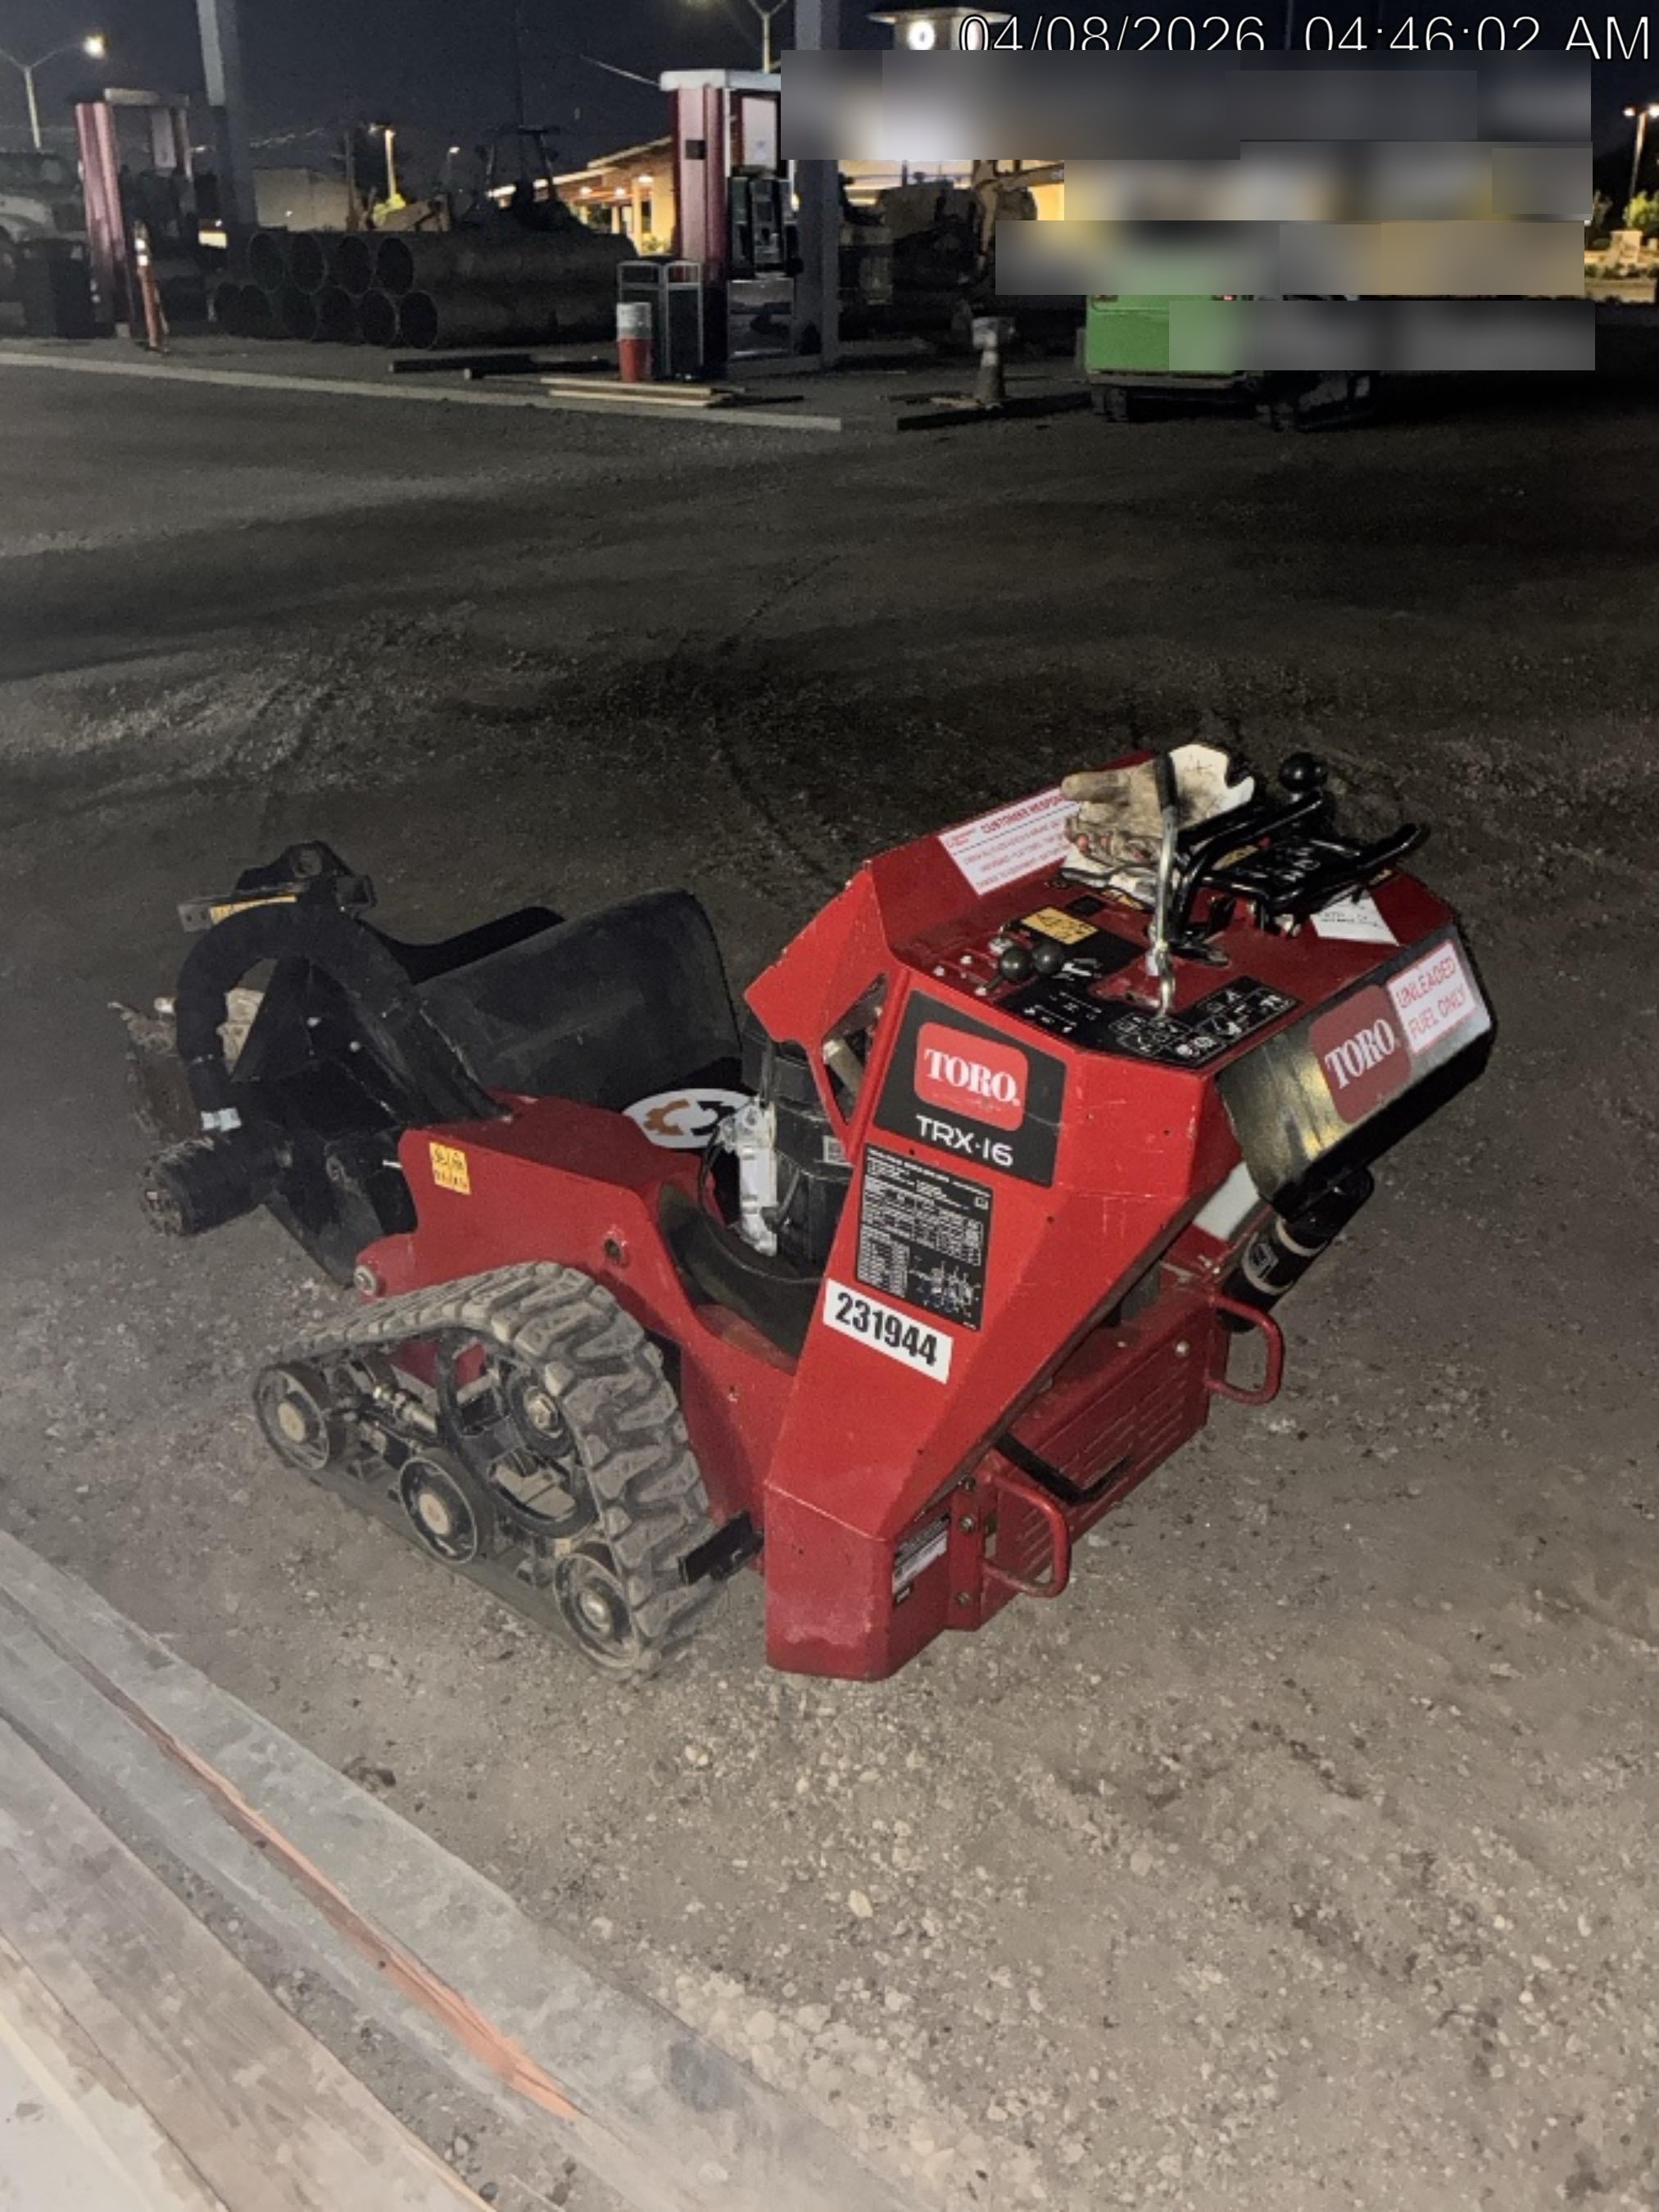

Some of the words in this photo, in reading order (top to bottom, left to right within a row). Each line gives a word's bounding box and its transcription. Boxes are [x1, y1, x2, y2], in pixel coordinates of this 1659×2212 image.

[981, 808, 1031, 834] CUSTOMER
[1396, 956, 1456, 1009] UNLEADED
[1409, 1008, 1439, 1039] FUEL
[1438, 984, 1466, 1018] ONLY
[924, 1048, 1018, 1103] TORO
[1324, 1018, 1396, 1090] TORO
[835, 1292, 938, 1366] 231944
